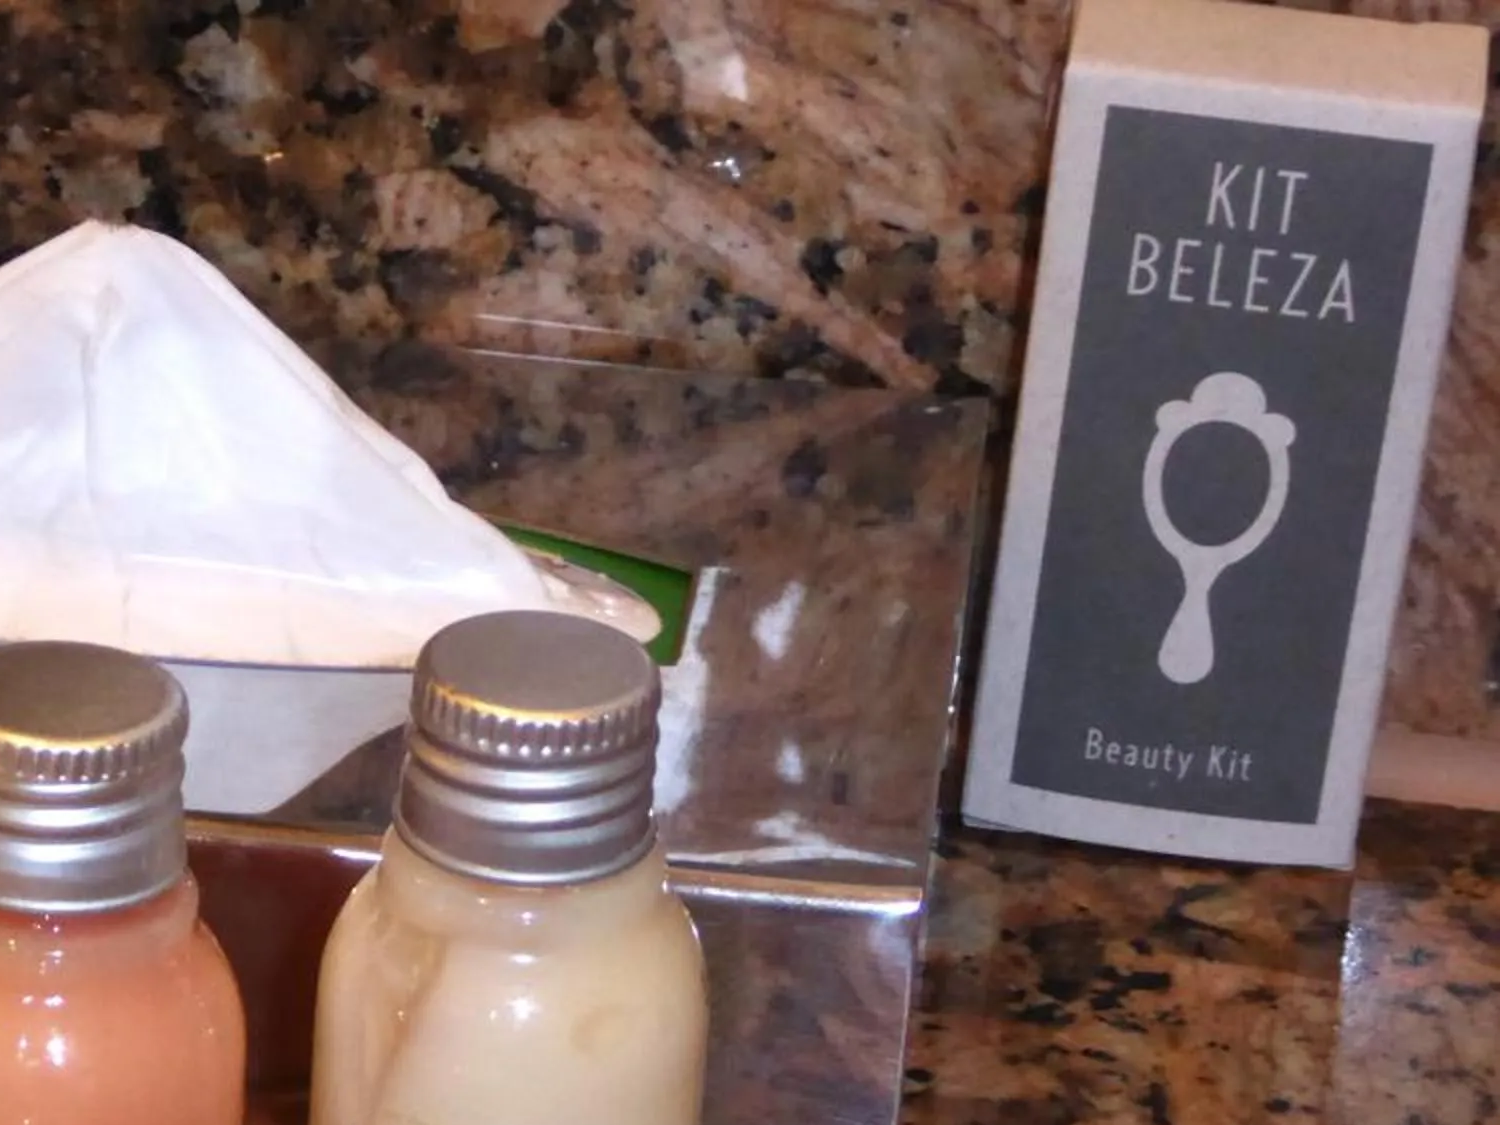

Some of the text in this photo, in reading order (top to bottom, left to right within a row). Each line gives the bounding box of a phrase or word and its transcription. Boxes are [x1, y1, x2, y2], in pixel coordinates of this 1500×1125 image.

[1205, 160, 1309, 235] KIT
[1126, 233, 1356, 323] BELEZA
[1084, 727, 1253, 783] Beauty Kit
